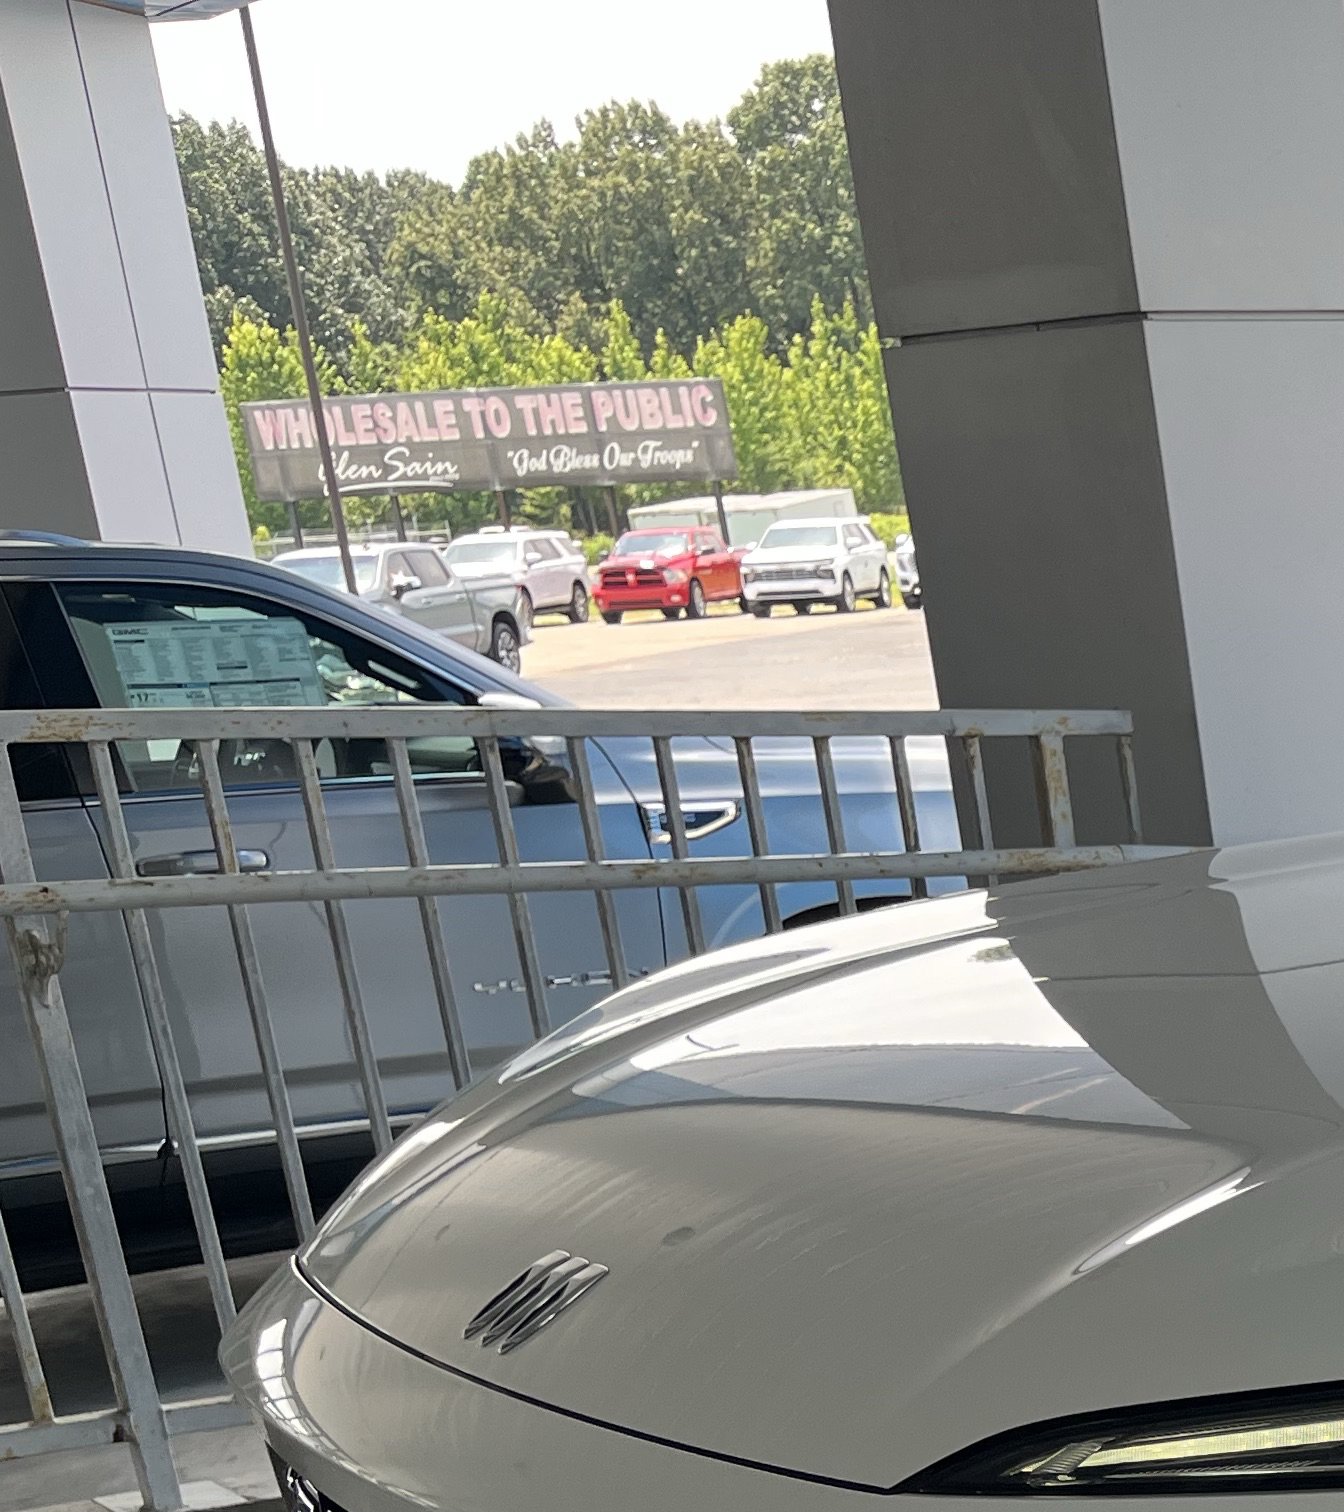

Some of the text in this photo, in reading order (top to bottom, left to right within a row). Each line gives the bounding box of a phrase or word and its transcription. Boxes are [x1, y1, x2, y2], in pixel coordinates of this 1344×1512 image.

[253, 384, 718, 450] WHOLESALE TO THE PUBLIC
[384, 446, 458, 481] Sain
[549, 444, 600, 473] Bless
[603, 441, 636, 470] Our
